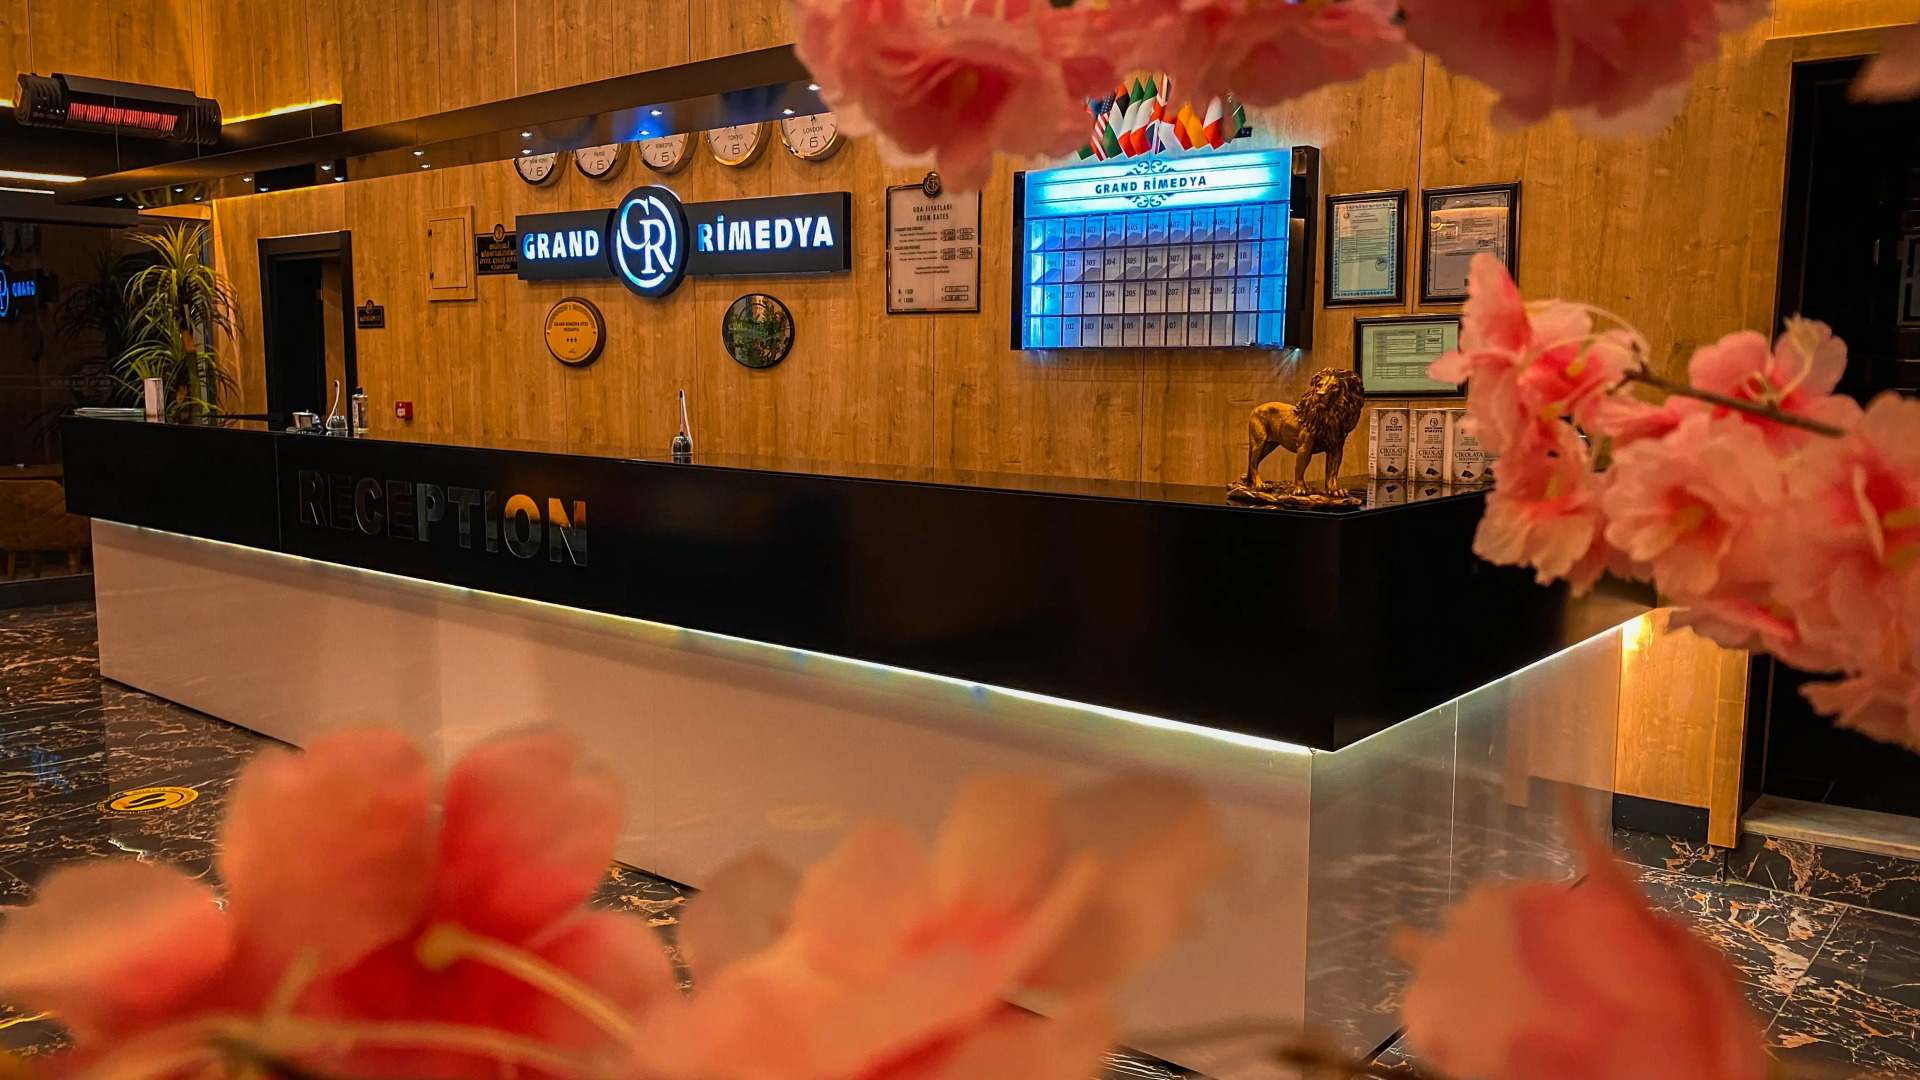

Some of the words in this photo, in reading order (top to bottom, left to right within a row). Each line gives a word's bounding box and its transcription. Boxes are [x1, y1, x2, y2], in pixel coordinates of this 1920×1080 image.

[803, 126, 823, 134] LONDON
[810, 136, 818, 148] 6
[732, 144, 740, 154] 6
[662, 152, 670, 162] 6
[596, 160, 604, 170] 6
[536, 166, 544, 176] 6
[1095, 182, 1138, 194] GRAND
[1144, 176, 1206, 190] RİMEDYA
[698, 214, 834, 252] RİMEDYA
[522, 230, 600, 260] GRAND
[298, 469, 588, 566] RECEPTION
